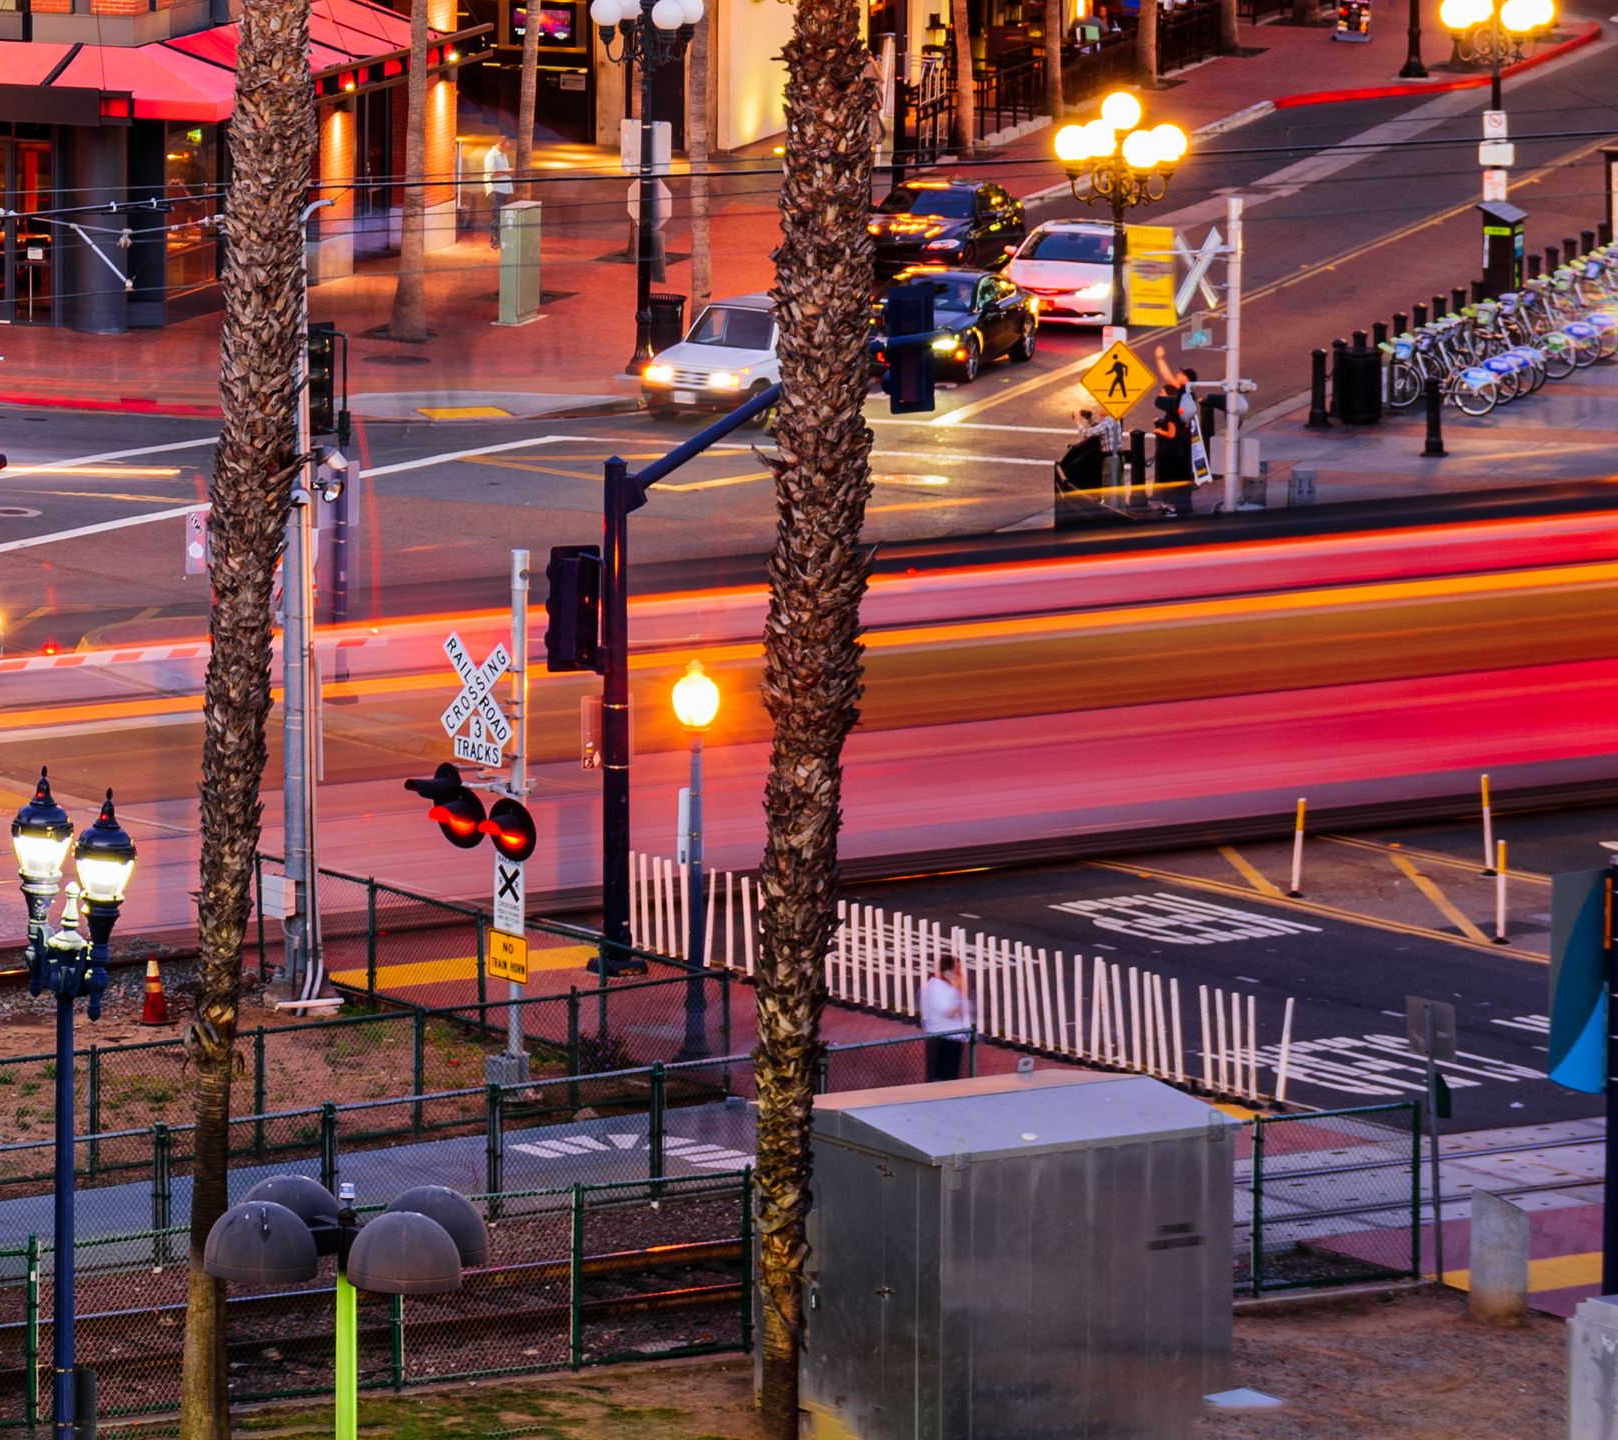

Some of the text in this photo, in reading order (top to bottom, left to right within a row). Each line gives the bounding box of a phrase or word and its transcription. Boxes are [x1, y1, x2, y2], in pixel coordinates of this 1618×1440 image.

[445, 650, 506, 729] CROSSING
[474, 718, 482, 739] 3
[456, 738, 499, 765] TRACKS
[502, 942, 514, 955] NO
[491, 957, 525, 975] TRAIN HORN
